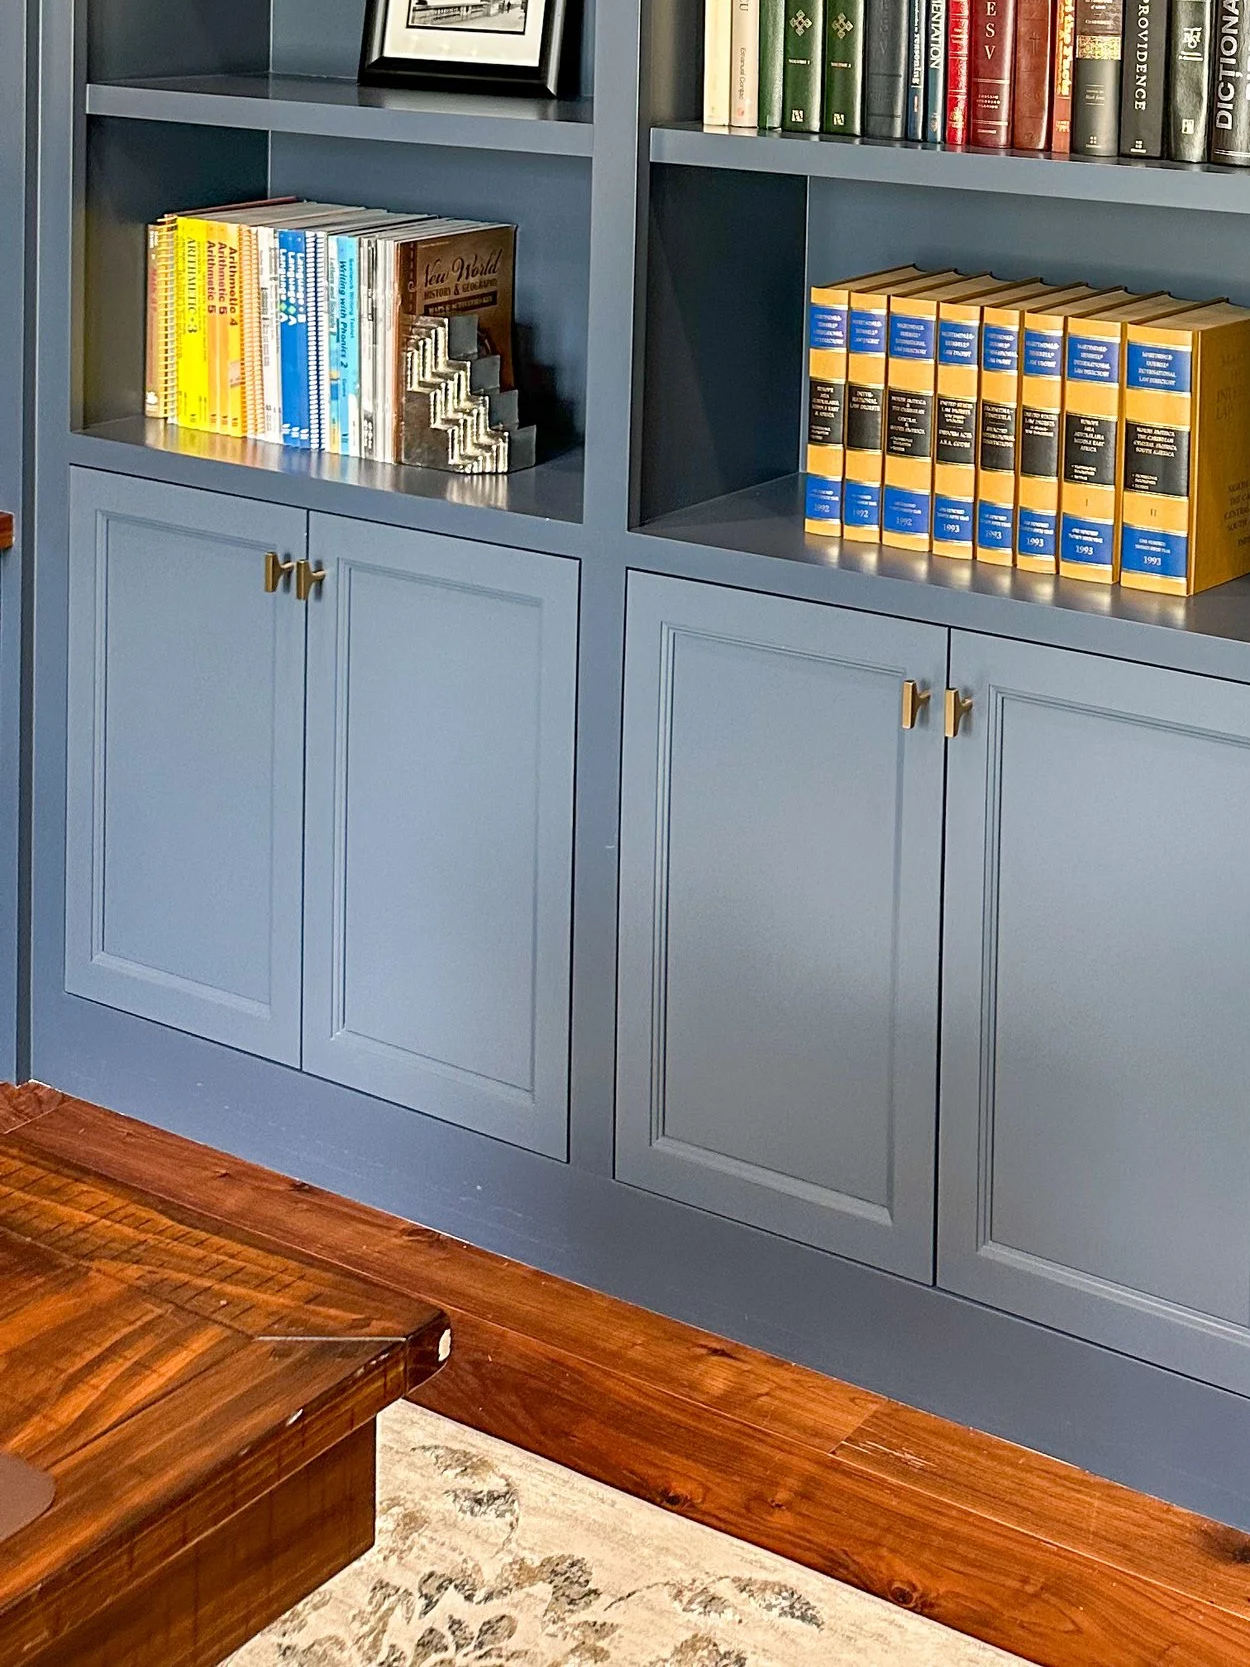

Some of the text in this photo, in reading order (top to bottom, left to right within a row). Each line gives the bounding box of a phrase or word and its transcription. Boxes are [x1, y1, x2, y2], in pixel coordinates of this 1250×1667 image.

[1062, 17, 1074, 43] the
[1060, 46, 1073, 95] Facts
[187, 237, 197, 314] ARITHMETIC
[207, 241, 216, 302] Arithmetic
[218, 242, 227, 302] Arithmetic
[287, 252, 296, 304] Language
[339, 261, 347, 295] Writing
[424, 249, 503, 287] New World
[229, 247, 237, 326] Arithmetic 4
[340, 298, 348, 319] with
[339, 322, 347, 358] Phonics
[814, 503, 830, 514] 1992
[942, 523, 960, 534] 1993
[1026, 537, 1044, 548] 1993
[1075, 543, 1094, 556] 1993
[1143, 555, 1161, 566] 1993
